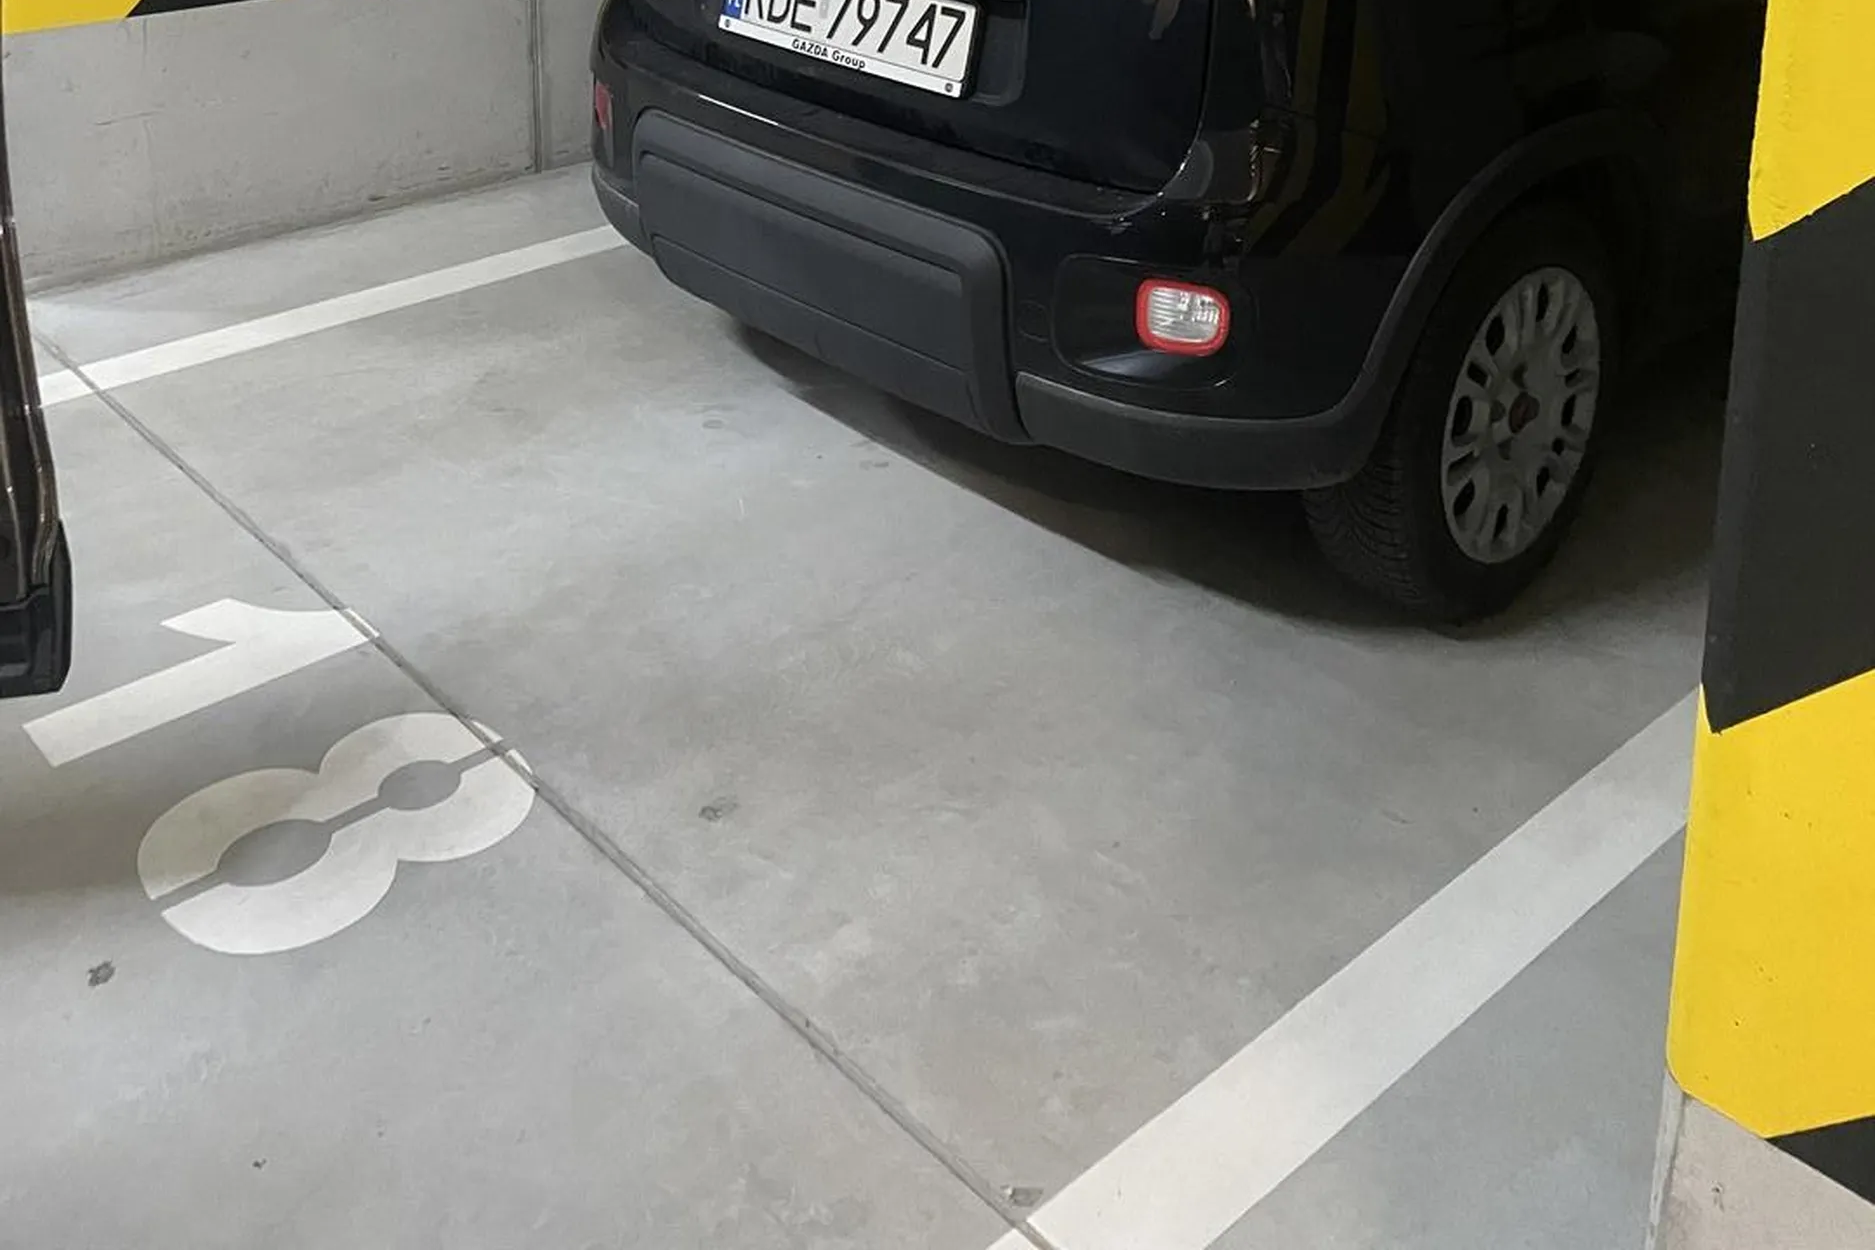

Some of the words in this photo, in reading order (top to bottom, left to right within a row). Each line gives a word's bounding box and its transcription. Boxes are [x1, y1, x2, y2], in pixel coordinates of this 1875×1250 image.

[791, 38, 829, 57] GAZDA
[831, 50, 866, 70] Group
[22, 597, 538, 955] 18
